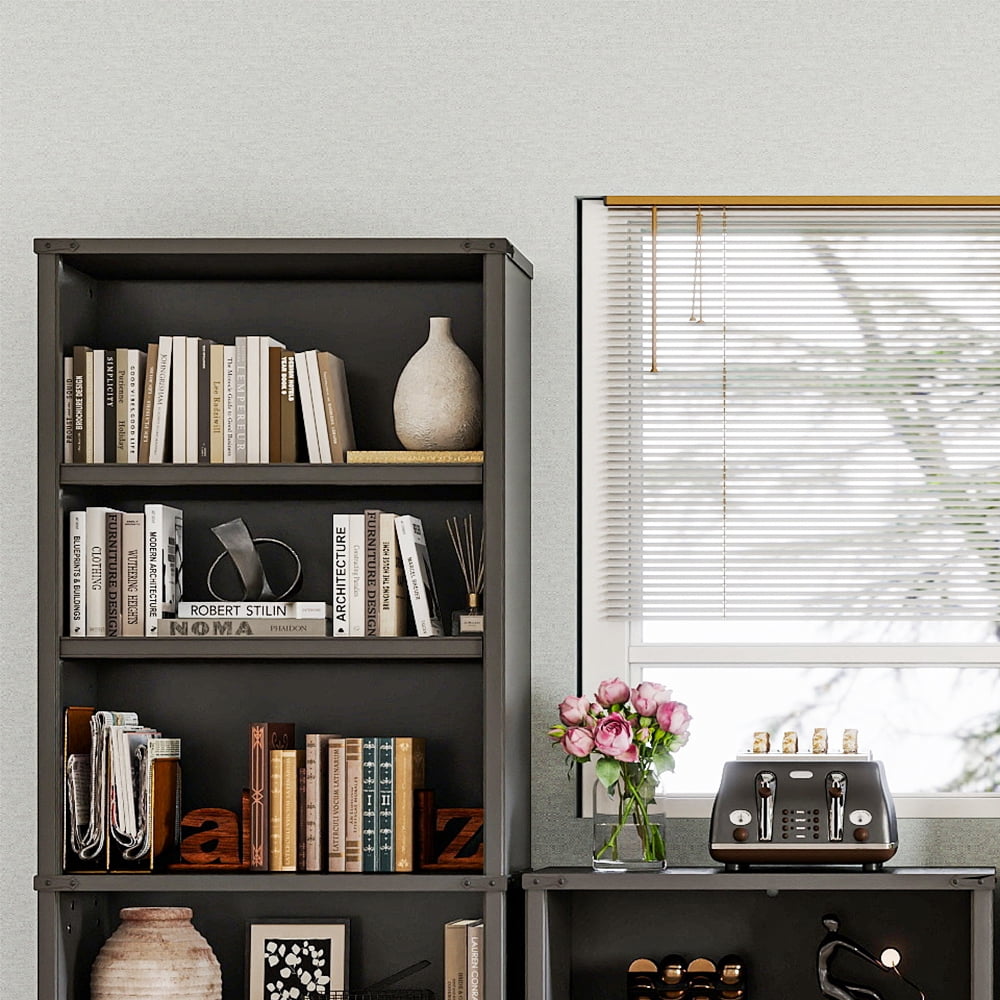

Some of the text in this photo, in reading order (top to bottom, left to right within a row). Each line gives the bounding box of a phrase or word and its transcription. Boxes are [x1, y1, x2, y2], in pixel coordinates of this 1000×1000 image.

[75, 376, 83, 397] DESIGN
[106, 356, 114, 407] SIMPLICITY
[75, 398, 83, 430] BROCHURE
[91, 546, 101, 591] CLOTHING
[149, 531, 157, 562] MODERN
[108, 514, 117, 637] FURNITURE DESIGN
[127, 549, 138, 625] WUTHERING HEIGHTS
[149, 563, 157, 617] ARCHITECTURE
[336, 527, 346, 622] ARCHITECTURE
[367, 512, 376, 637] FURNITURE DESIGN
[169, 621, 253, 636] NOMA
[190, 604, 287, 616] ROBERT STILIN
[180, 808, 240, 864] a
[471, 936, 479, 969] LAUREN
